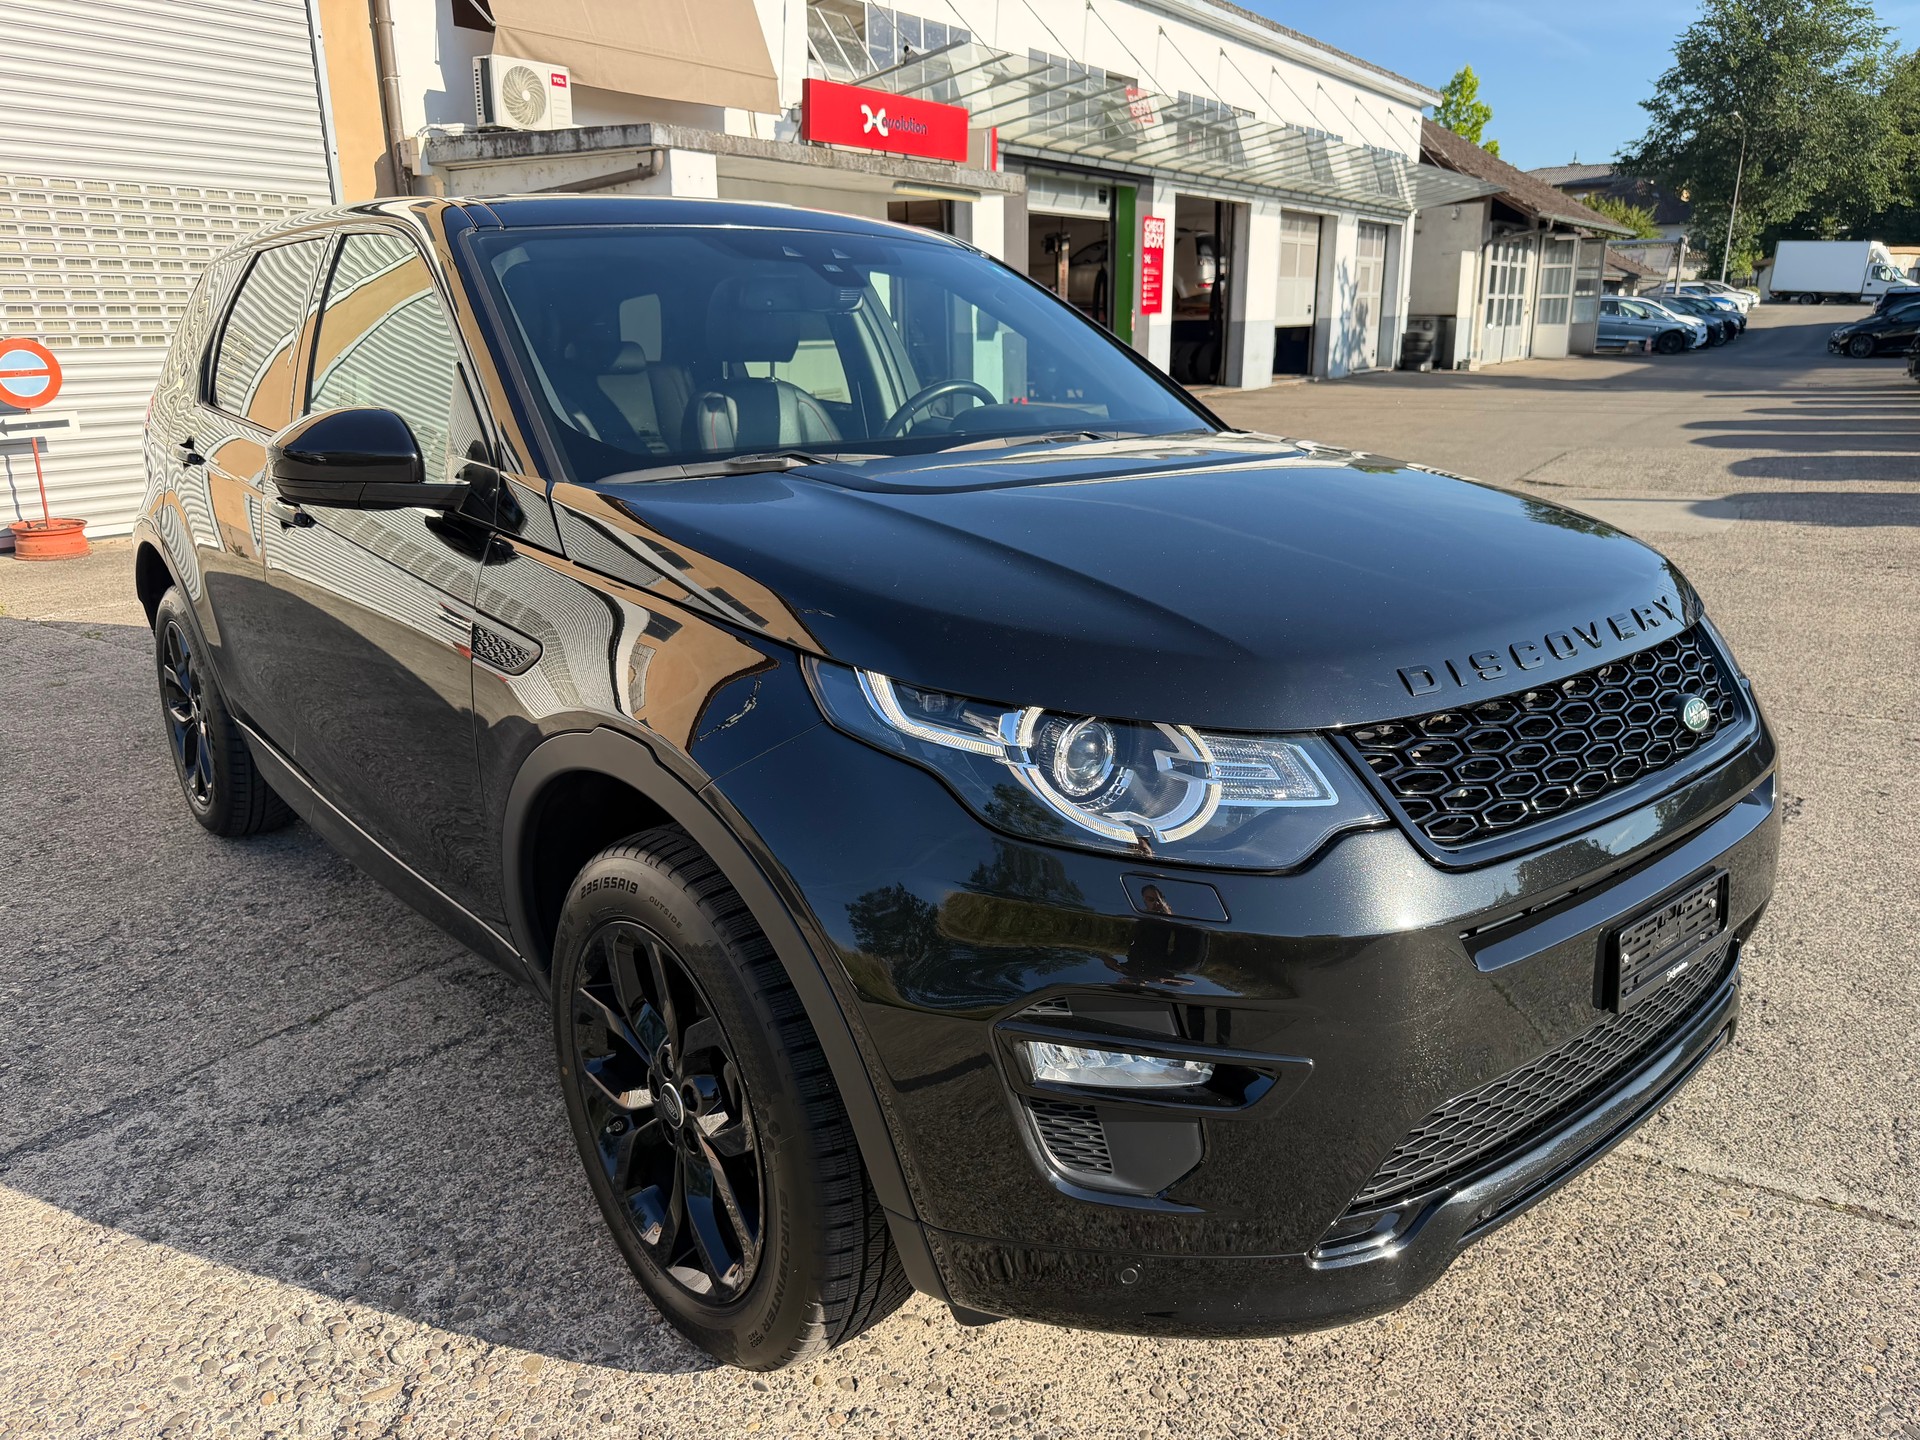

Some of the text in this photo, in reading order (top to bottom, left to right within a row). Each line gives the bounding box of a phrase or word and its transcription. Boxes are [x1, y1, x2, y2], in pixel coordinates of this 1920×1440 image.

[552, 76, 566, 85] TCL
[1143, 231, 1165, 249] BOX
[1396, 594, 1677, 697] DISCOVERY
[580, 876, 639, 900] 235/55R19
[649, 895, 683, 930] OUTSIDE
[761, 1187, 791, 1333] EUROWINTER
